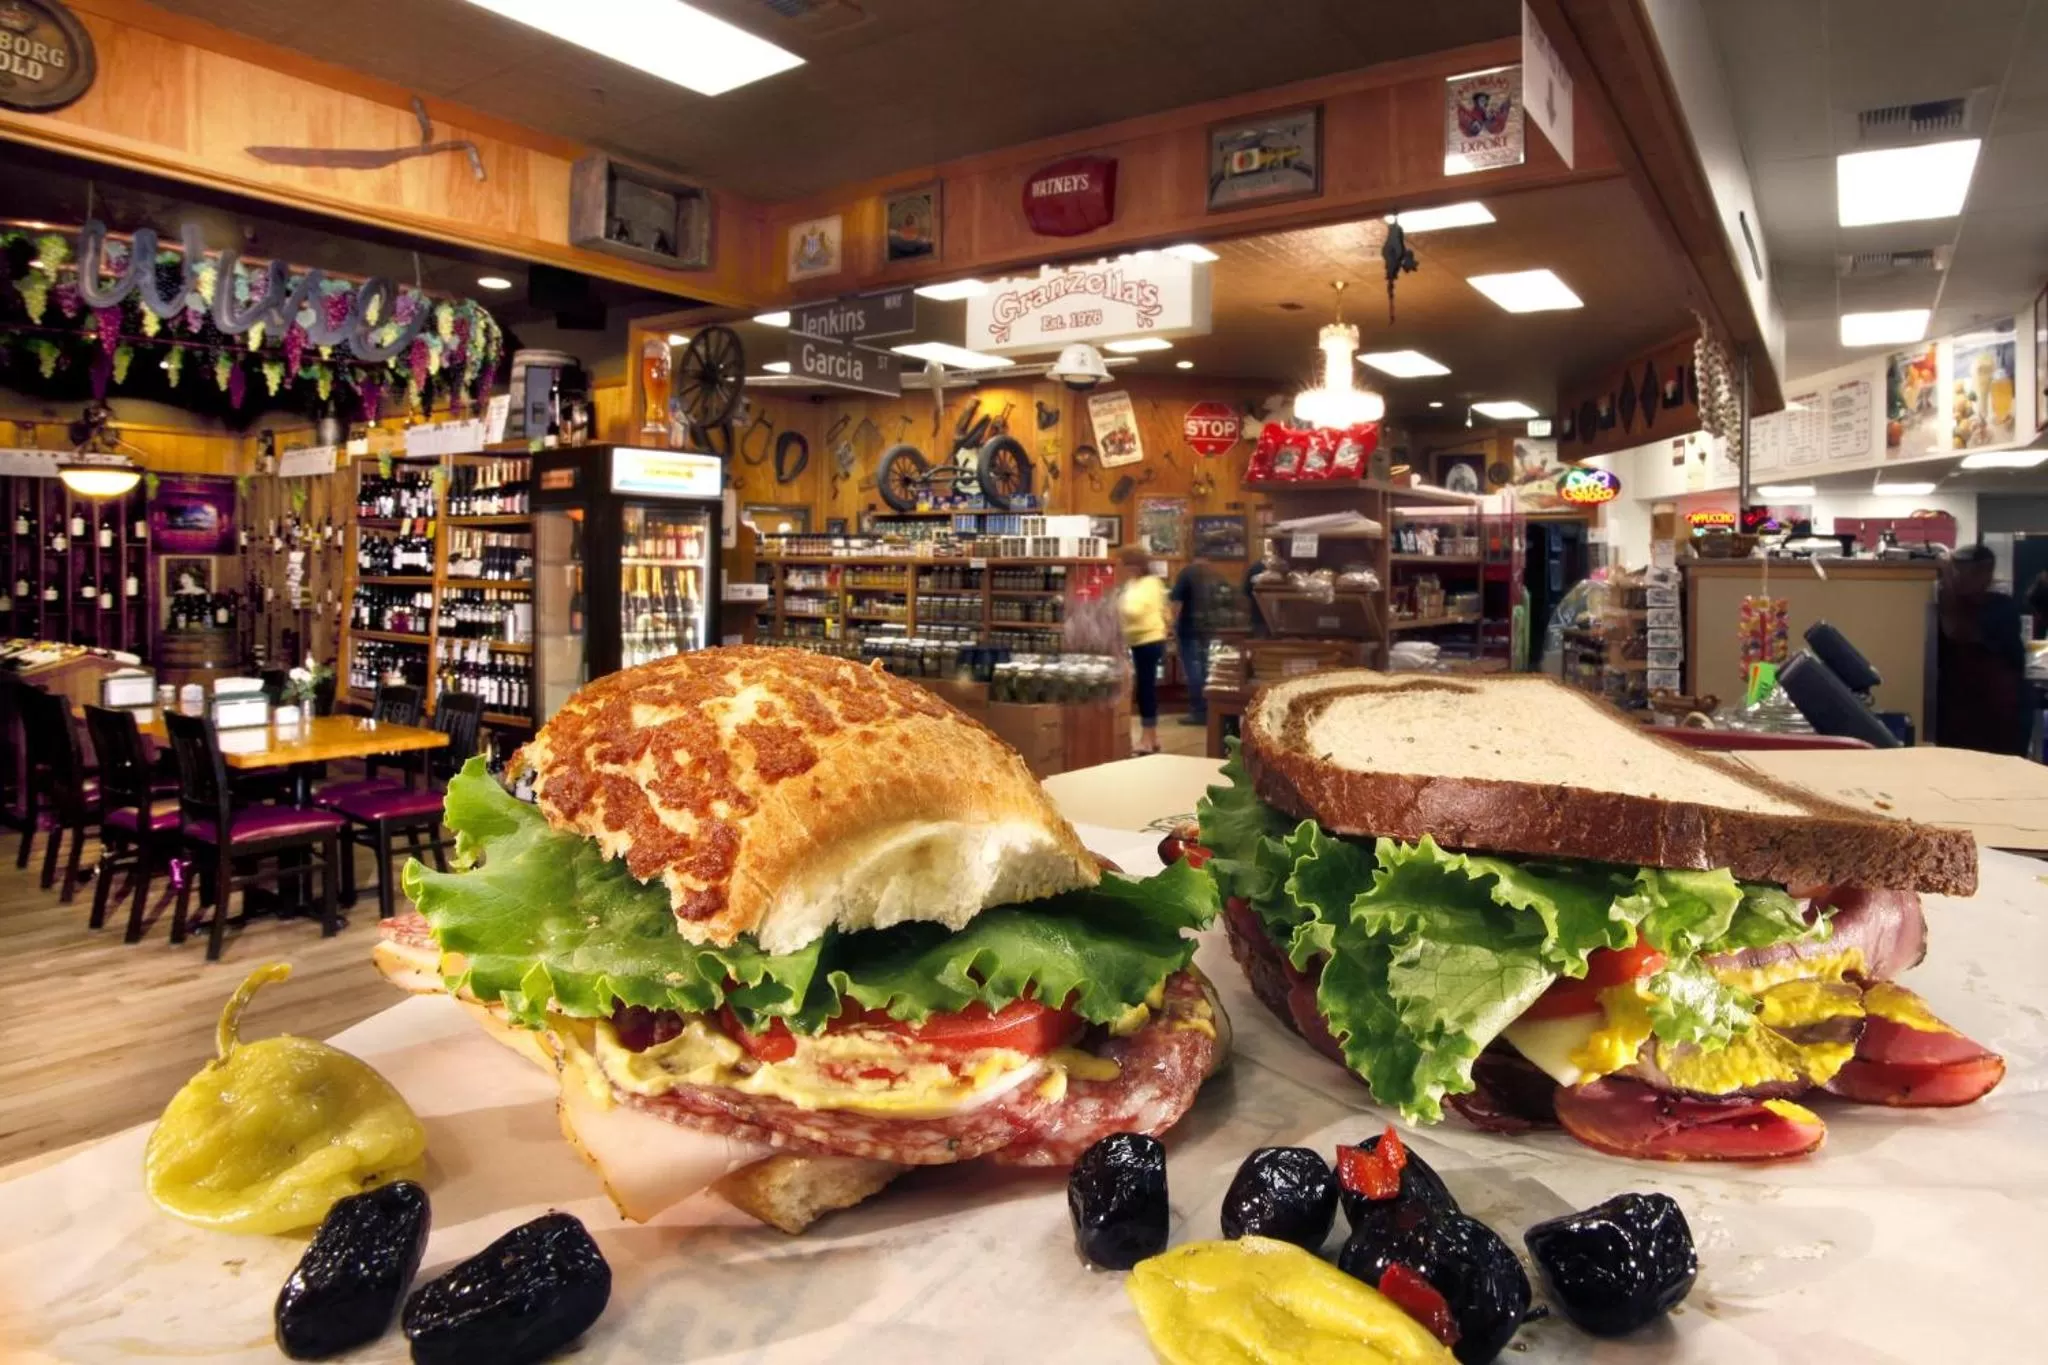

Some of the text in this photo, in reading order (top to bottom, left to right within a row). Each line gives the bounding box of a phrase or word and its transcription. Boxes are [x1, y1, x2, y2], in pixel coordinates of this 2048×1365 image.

[992, 267, 1160, 326] Granzella's
[802, 306, 866, 336] Jenkins
[1040, 315, 1066, 332] Est.
[802, 343, 864, 381] Garcia
[1185, 420, 1236, 437] STOP
